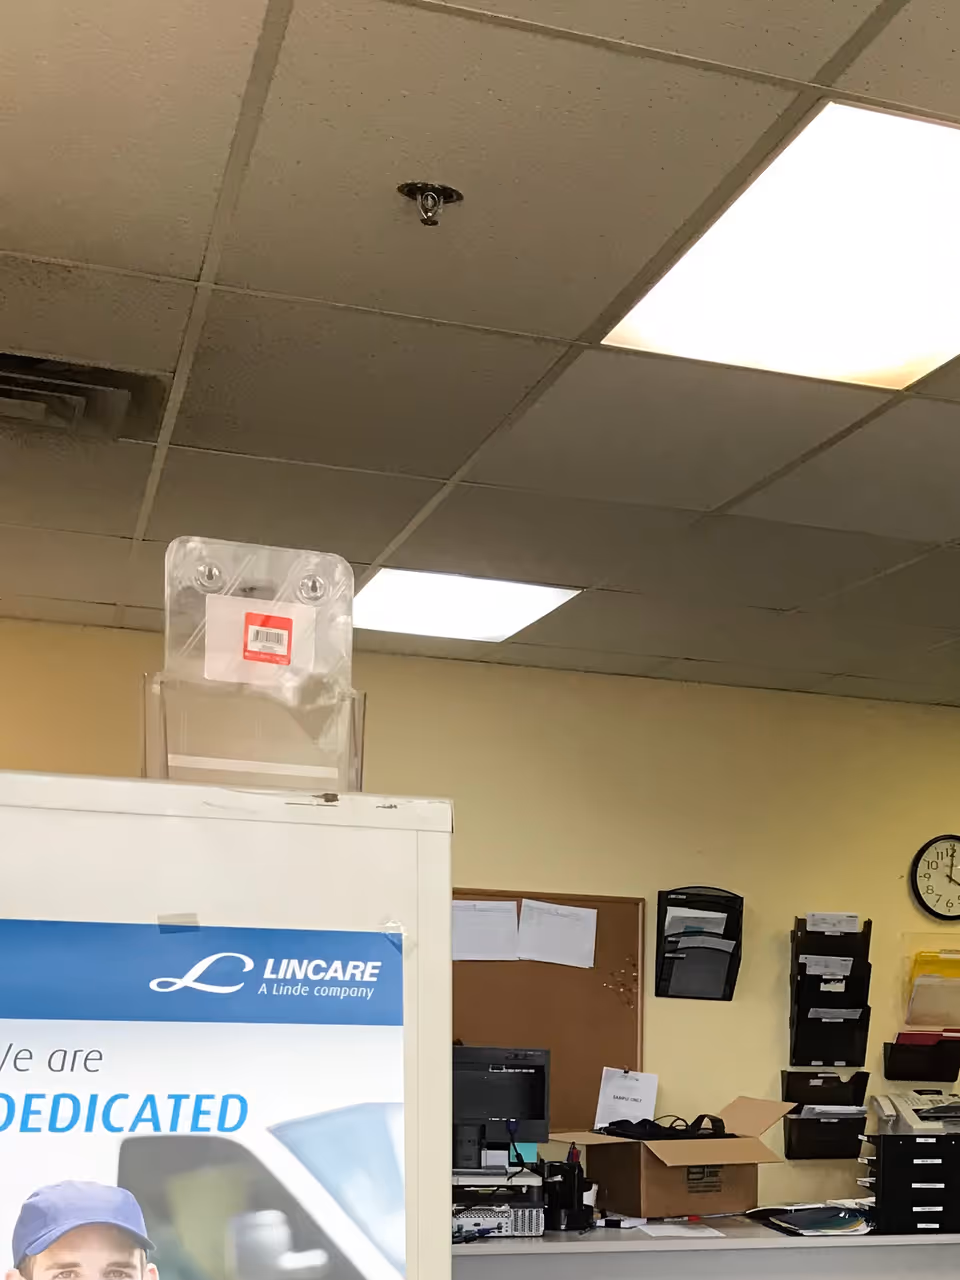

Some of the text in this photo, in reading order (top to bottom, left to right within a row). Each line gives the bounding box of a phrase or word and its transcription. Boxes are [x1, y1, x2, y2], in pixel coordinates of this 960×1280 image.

[936, 851, 944, 861] 11
[927, 860, 939, 870] 10
[923, 872, 932, 881] 9
[926, 885, 935, 895] 8
[935, 893, 943, 904] 7
[945, 899, 954, 908] 6
[263, 958, 382, 982] LINCARE
[258, 983, 375, 1000] A Linde company
[0, 1043, 103, 1073] e are
